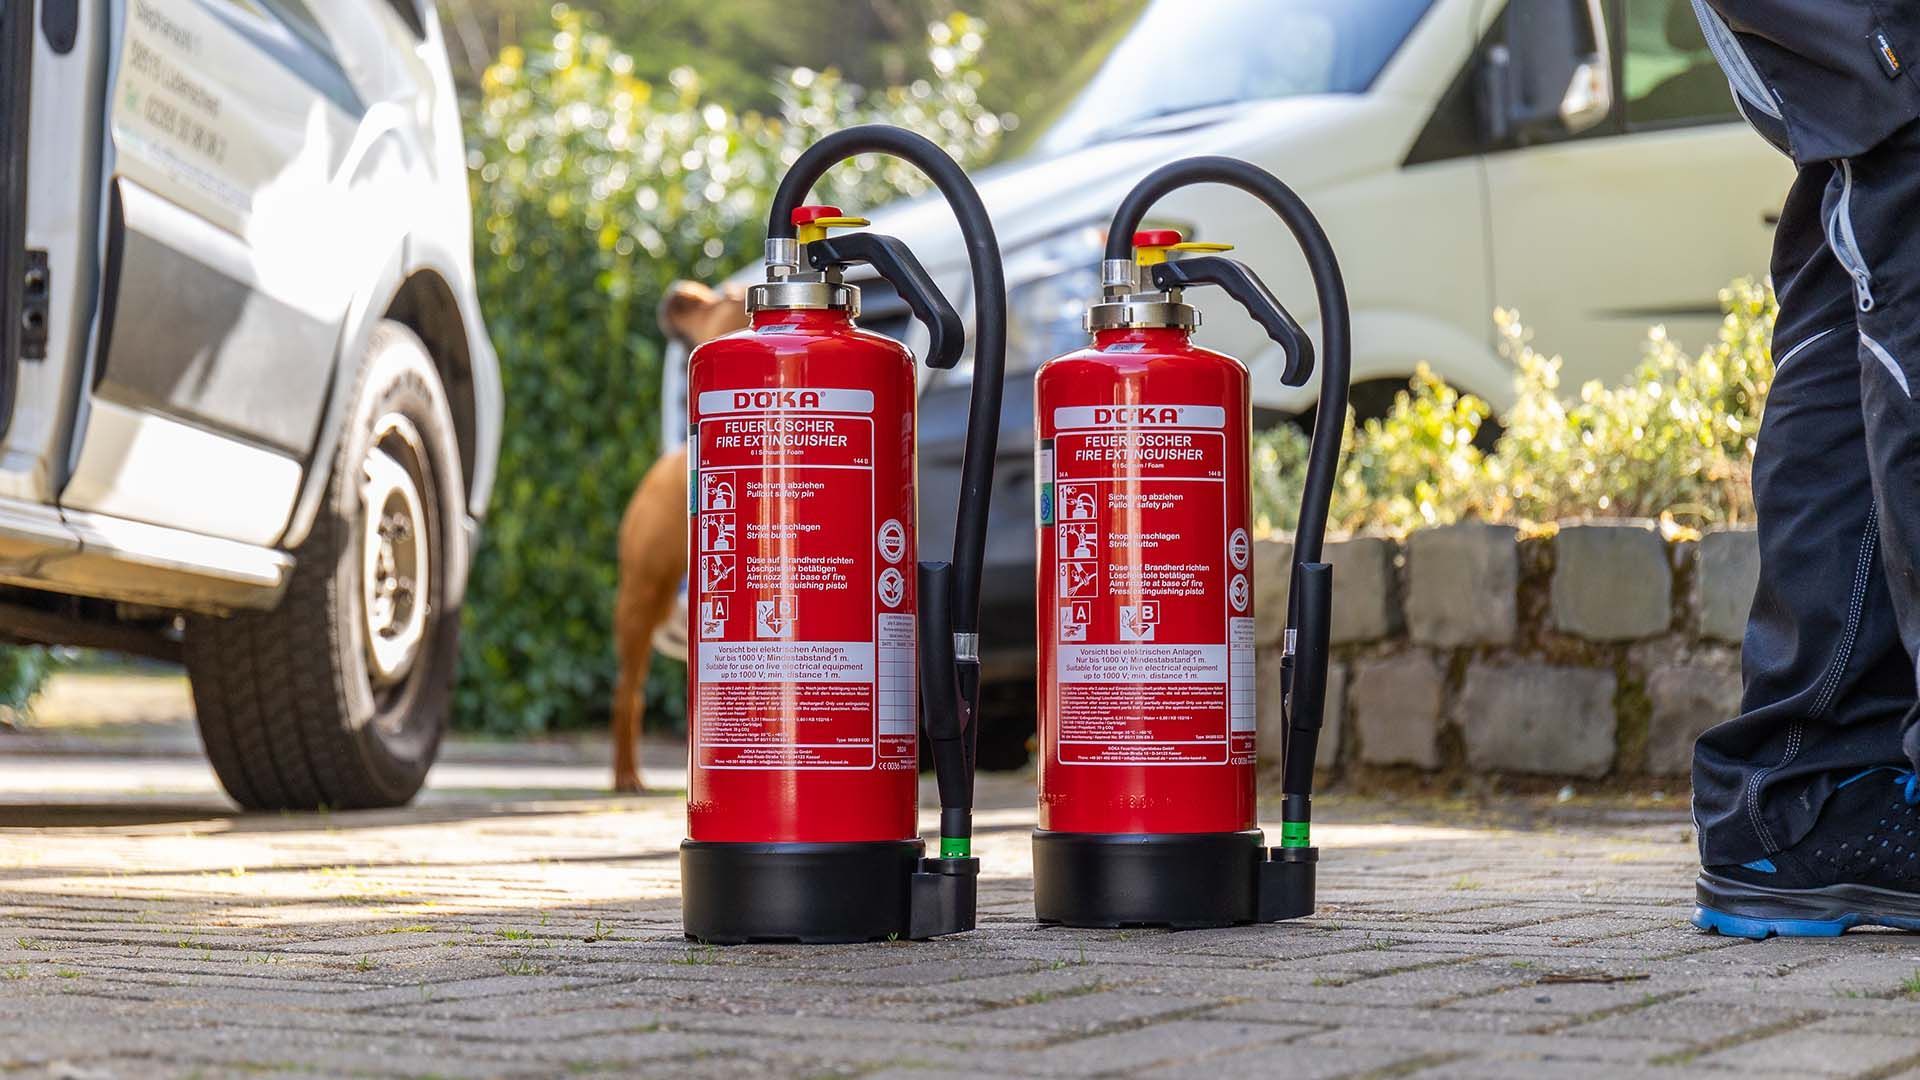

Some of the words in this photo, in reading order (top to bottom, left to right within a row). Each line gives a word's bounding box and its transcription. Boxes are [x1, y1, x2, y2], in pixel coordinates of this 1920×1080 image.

[725, 418, 835, 433] FEUERLÖSCHER
[716, 436, 741, 448] FIRE
[744, 434, 848, 447] EXTINGUISHER
[1076, 449, 1102, 461] FIRE
[1105, 449, 1203, 460] EXTNGUISHER
[746, 482, 785, 490] Sicherung
[787, 481, 824, 489] abziehen
[774, 490, 800, 499] safety
[801, 490, 814, 499] pin
[1149, 493, 1183, 501] abziehen
[1136, 501, 1160, 510] safety
[1162, 501, 1174, 510] pin
[702, 517, 707, 529] 2
[746, 523, 769, 532] Knopf
[746, 531, 769, 539] Strike
[1060, 526, 1066, 538] 2
[1108, 532, 1132, 541] Knop
[702, 558, 708, 570] 3
[746, 556, 766, 564] Düse
[767, 556, 780, 564] auf
[826, 556, 854, 565] richten
[798, 565, 837, 574] betätigen
[1060, 565, 1067, 577] 3
[1144, 563, 1185, 571] Brandherd
[1186, 563, 1210, 571] richten
[746, 573, 761, 581] Aim
[1159, 572, 1195, 580] betätigen
[746, 581, 768, 589] Press
[825, 581, 848, 590] pistol
[1185, 588, 1205, 596] pistol
[715, 601, 724, 615] A
[1142, 605, 1154, 620] B
[1076, 606, 1087, 620] A
[811, 646, 844, 655] Anlagen
[1172, 648, 1202, 657] Anlagen
[822, 663, 864, 671] equipment
[1182, 664, 1218, 673] equipment
[758, 671, 766, 679] V;
